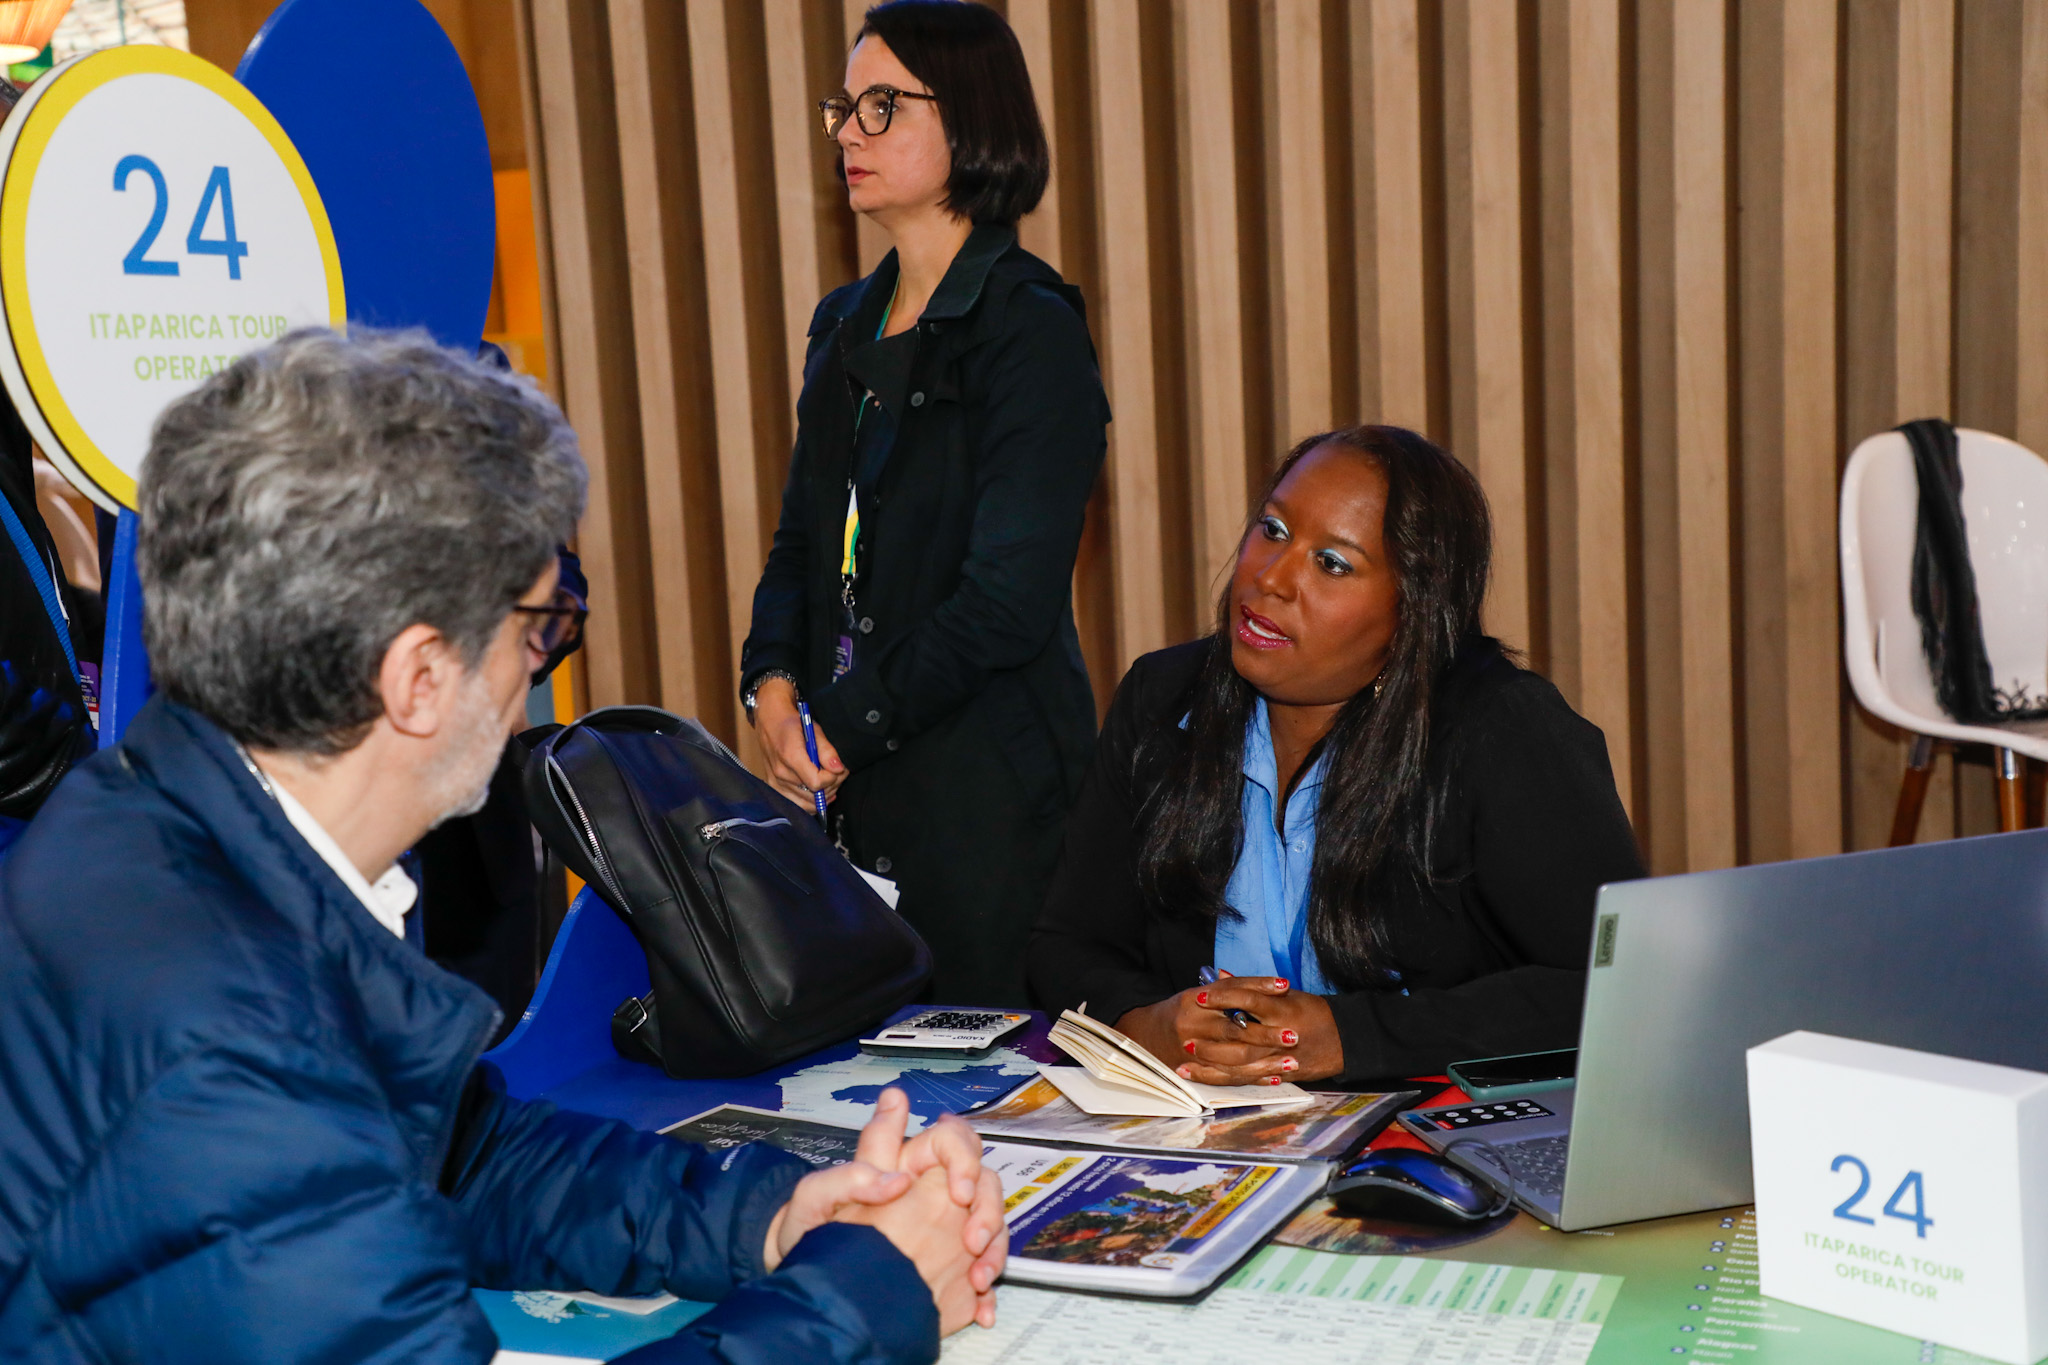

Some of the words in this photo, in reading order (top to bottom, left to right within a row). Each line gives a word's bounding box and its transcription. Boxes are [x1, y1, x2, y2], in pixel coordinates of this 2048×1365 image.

[112, 154, 249, 281] 24
[89, 313, 224, 340] ITAPARICA
[227, 314, 288, 340] TOUR
[134, 355, 241, 381] OPERAT
[1599, 918, 1614, 964] Lenovo
[707, 1137, 740, 1148] Sur
[1828, 1154, 1935, 1240] 24
[1804, 1231, 1907, 1270] ITAPARICA
[1911, 1256, 1965, 1286] TOUR
[1835, 1263, 1938, 1301] OPERATOR
